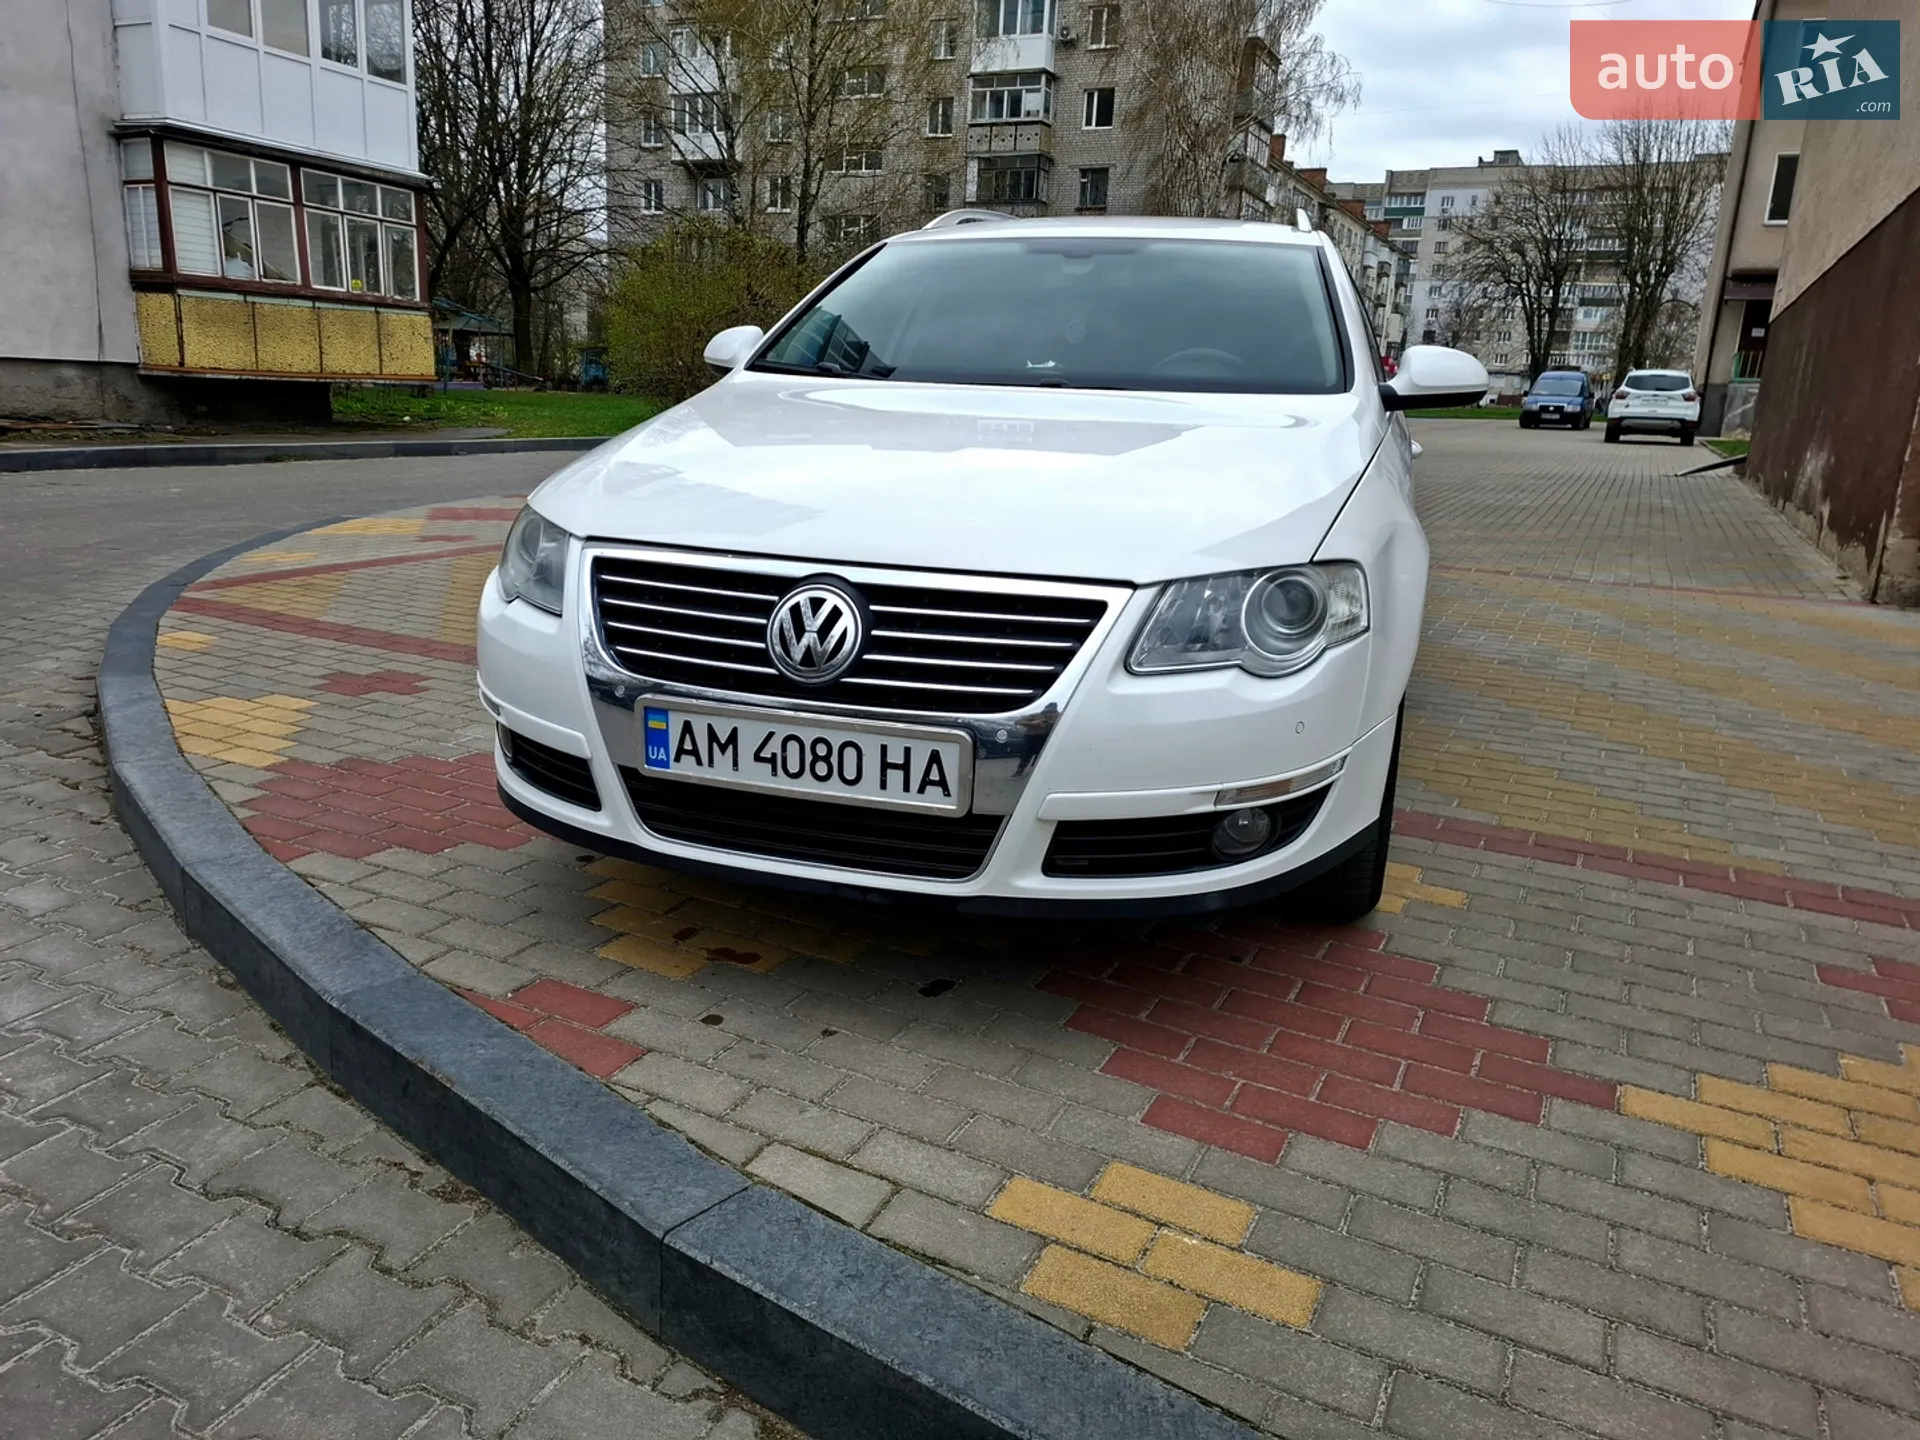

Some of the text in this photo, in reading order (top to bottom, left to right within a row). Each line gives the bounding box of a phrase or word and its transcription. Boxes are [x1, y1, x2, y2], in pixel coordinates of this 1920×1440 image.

[648, 745, 668, 762] UA
[673, 719, 952, 797] AM 4080 HA
